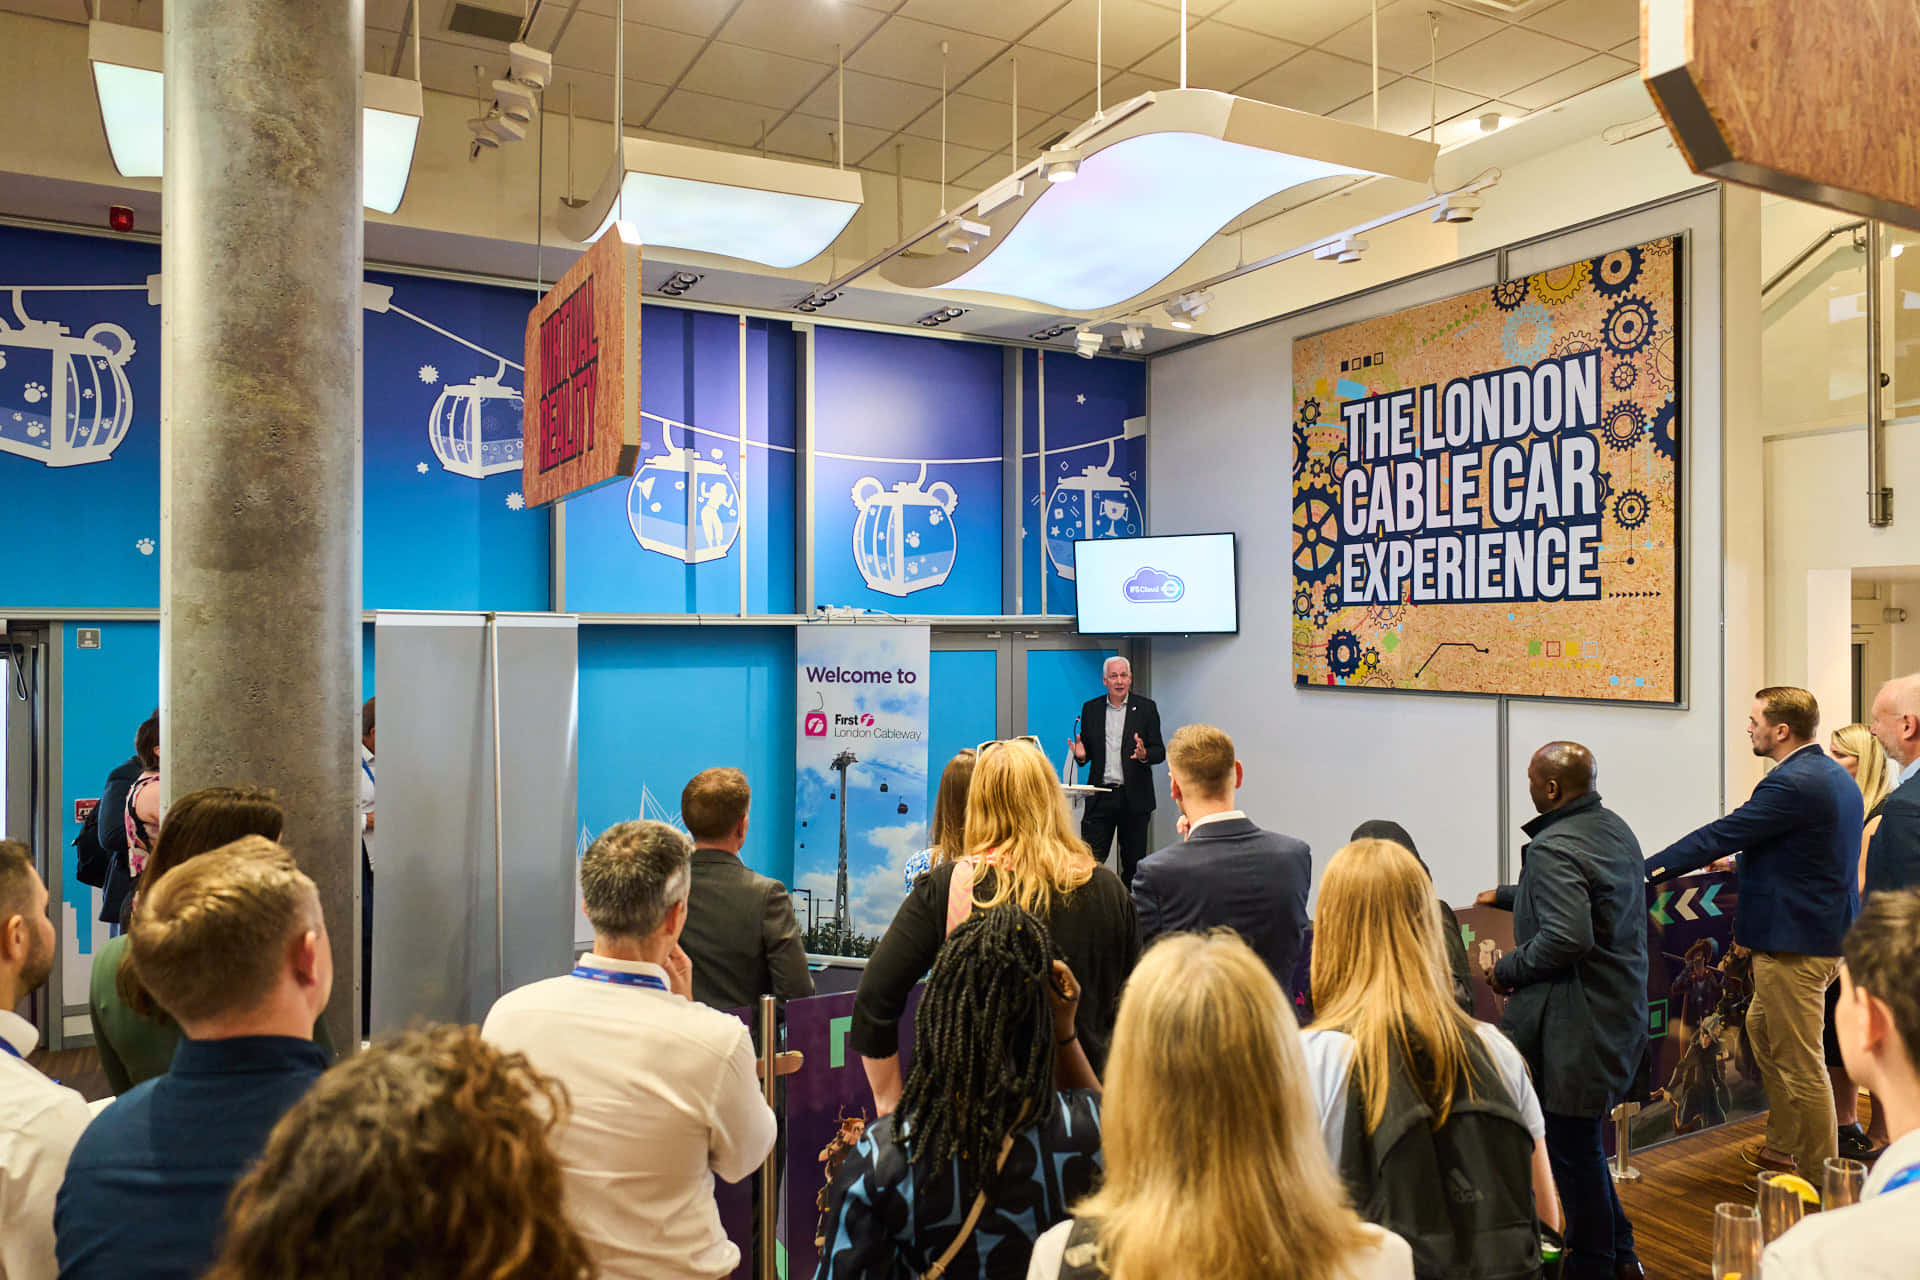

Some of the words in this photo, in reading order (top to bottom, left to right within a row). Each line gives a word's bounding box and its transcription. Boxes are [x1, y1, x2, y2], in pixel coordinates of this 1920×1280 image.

[540, 272, 599, 402] VIRTUAL
[539, 360, 599, 475] REALITY
[1342, 391, 1415, 464] THE
[1422, 352, 1598, 453] LONDON
[1342, 450, 1480, 538] CABLE
[1491, 434, 1598, 525] CAR
[1342, 523, 1598, 603] EXPERIENCE
[806, 666, 892, 684] Welcome
[897, 668, 917, 684] to
[835, 714, 859, 726] First
[834, 727, 872, 739] London
[873, 728, 921, 742] Cableway
